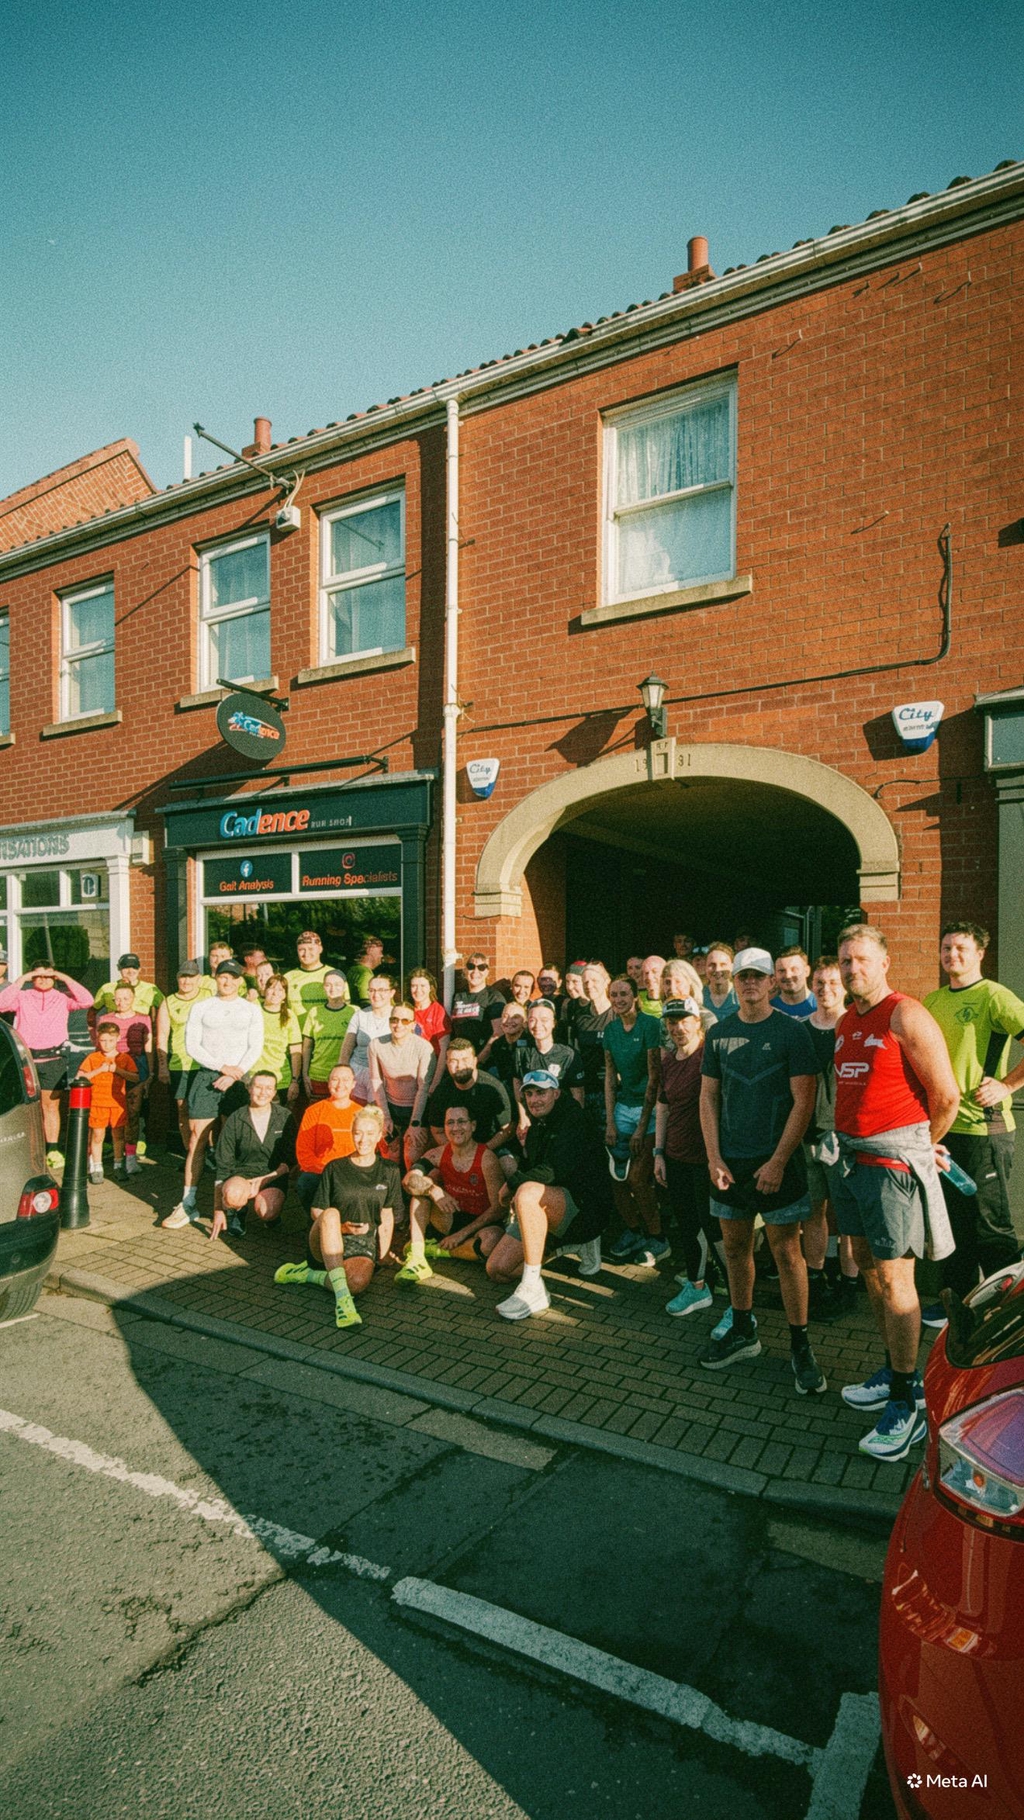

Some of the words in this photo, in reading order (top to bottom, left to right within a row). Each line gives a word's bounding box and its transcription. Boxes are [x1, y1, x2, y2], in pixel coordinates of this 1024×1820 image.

[899, 707, 934, 721] City
[220, 808, 310, 838] Cadence
[219, 880, 237, 892] Gait
[238, 879, 274, 892] Analysis
[302, 873, 342, 888] Running
[343, 870, 398, 886] Specialists
